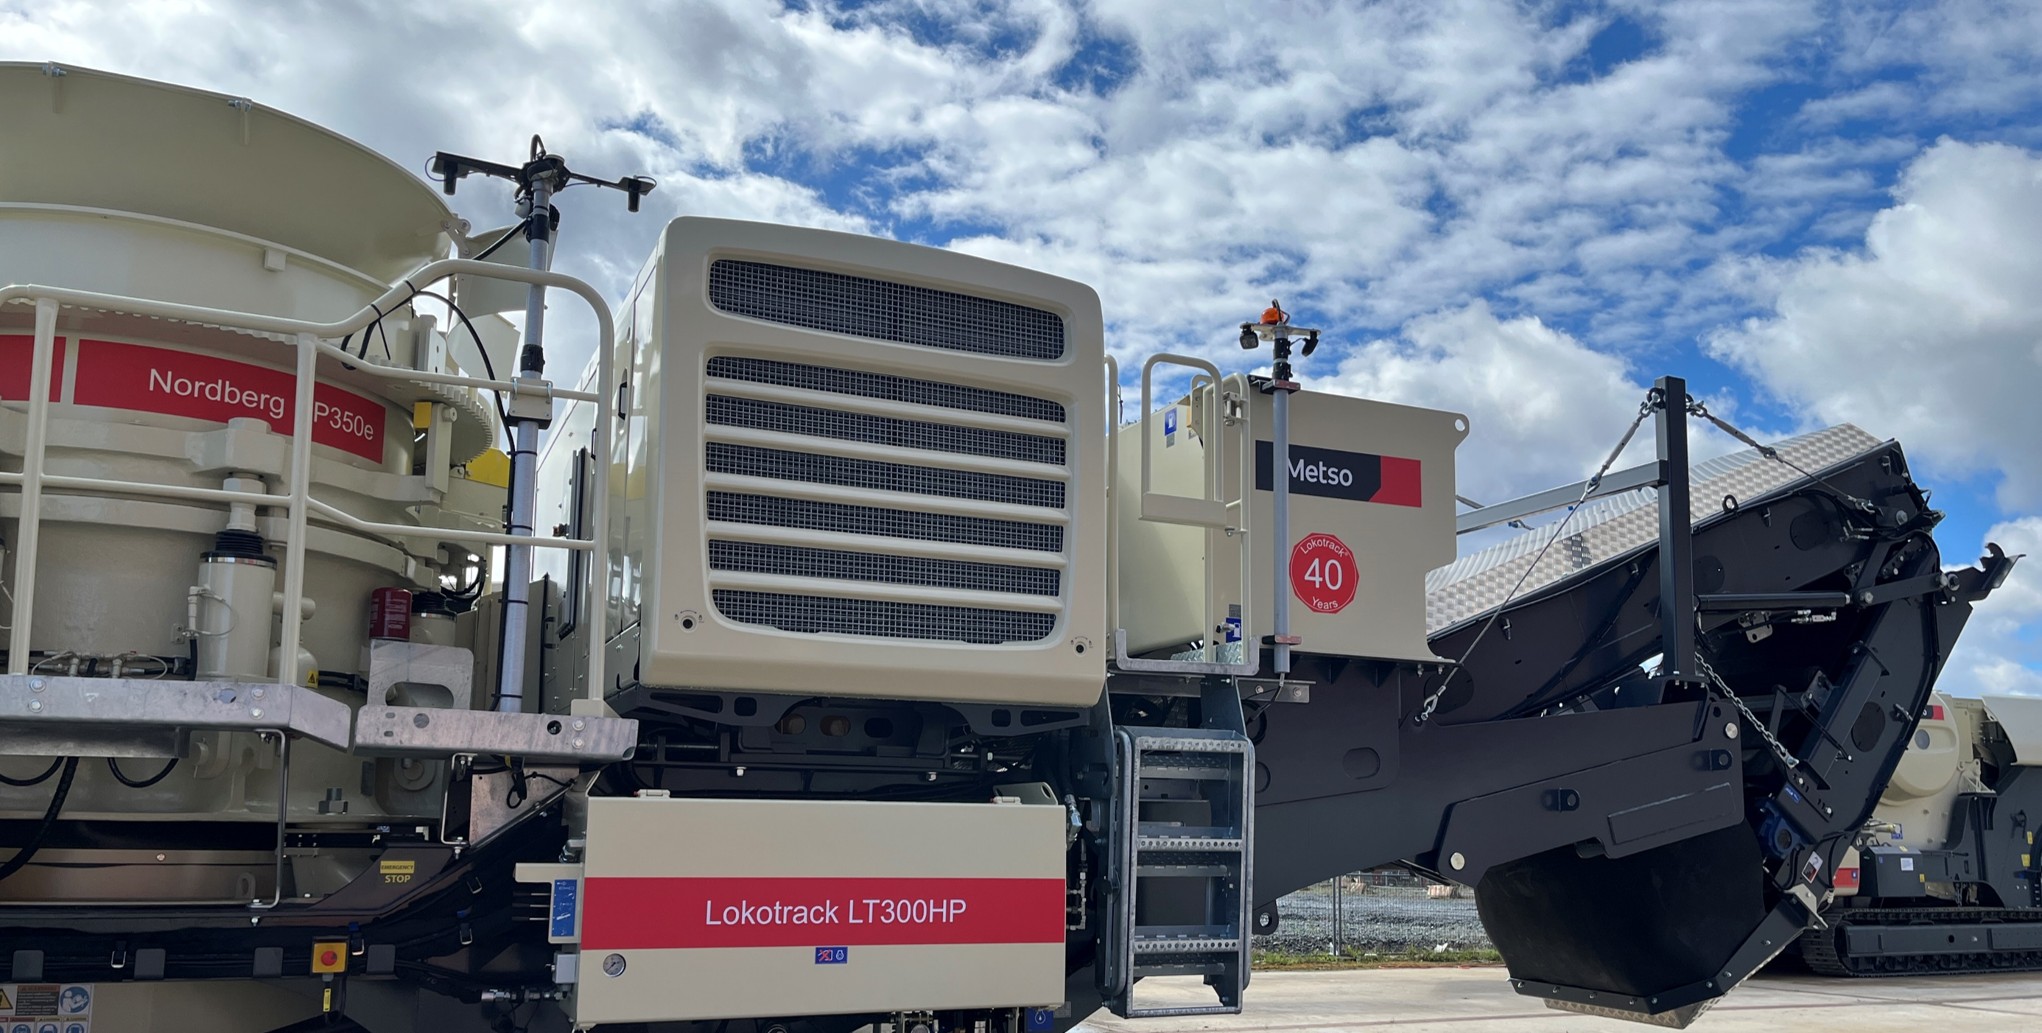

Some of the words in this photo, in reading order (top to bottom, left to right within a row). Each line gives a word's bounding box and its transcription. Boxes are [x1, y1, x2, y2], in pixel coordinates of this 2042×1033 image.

[149, 368, 285, 419] Nordberg
[313, 402, 374, 440] P350e
[1288, 457, 1353, 487] Metso
[1304, 558, 1342, 590] 40
[1312, 596, 1338, 609] Years
[385, 874, 411, 883] STOP
[705, 900, 839, 925] Lokotrack
[848, 899, 967, 923] LT300HP
